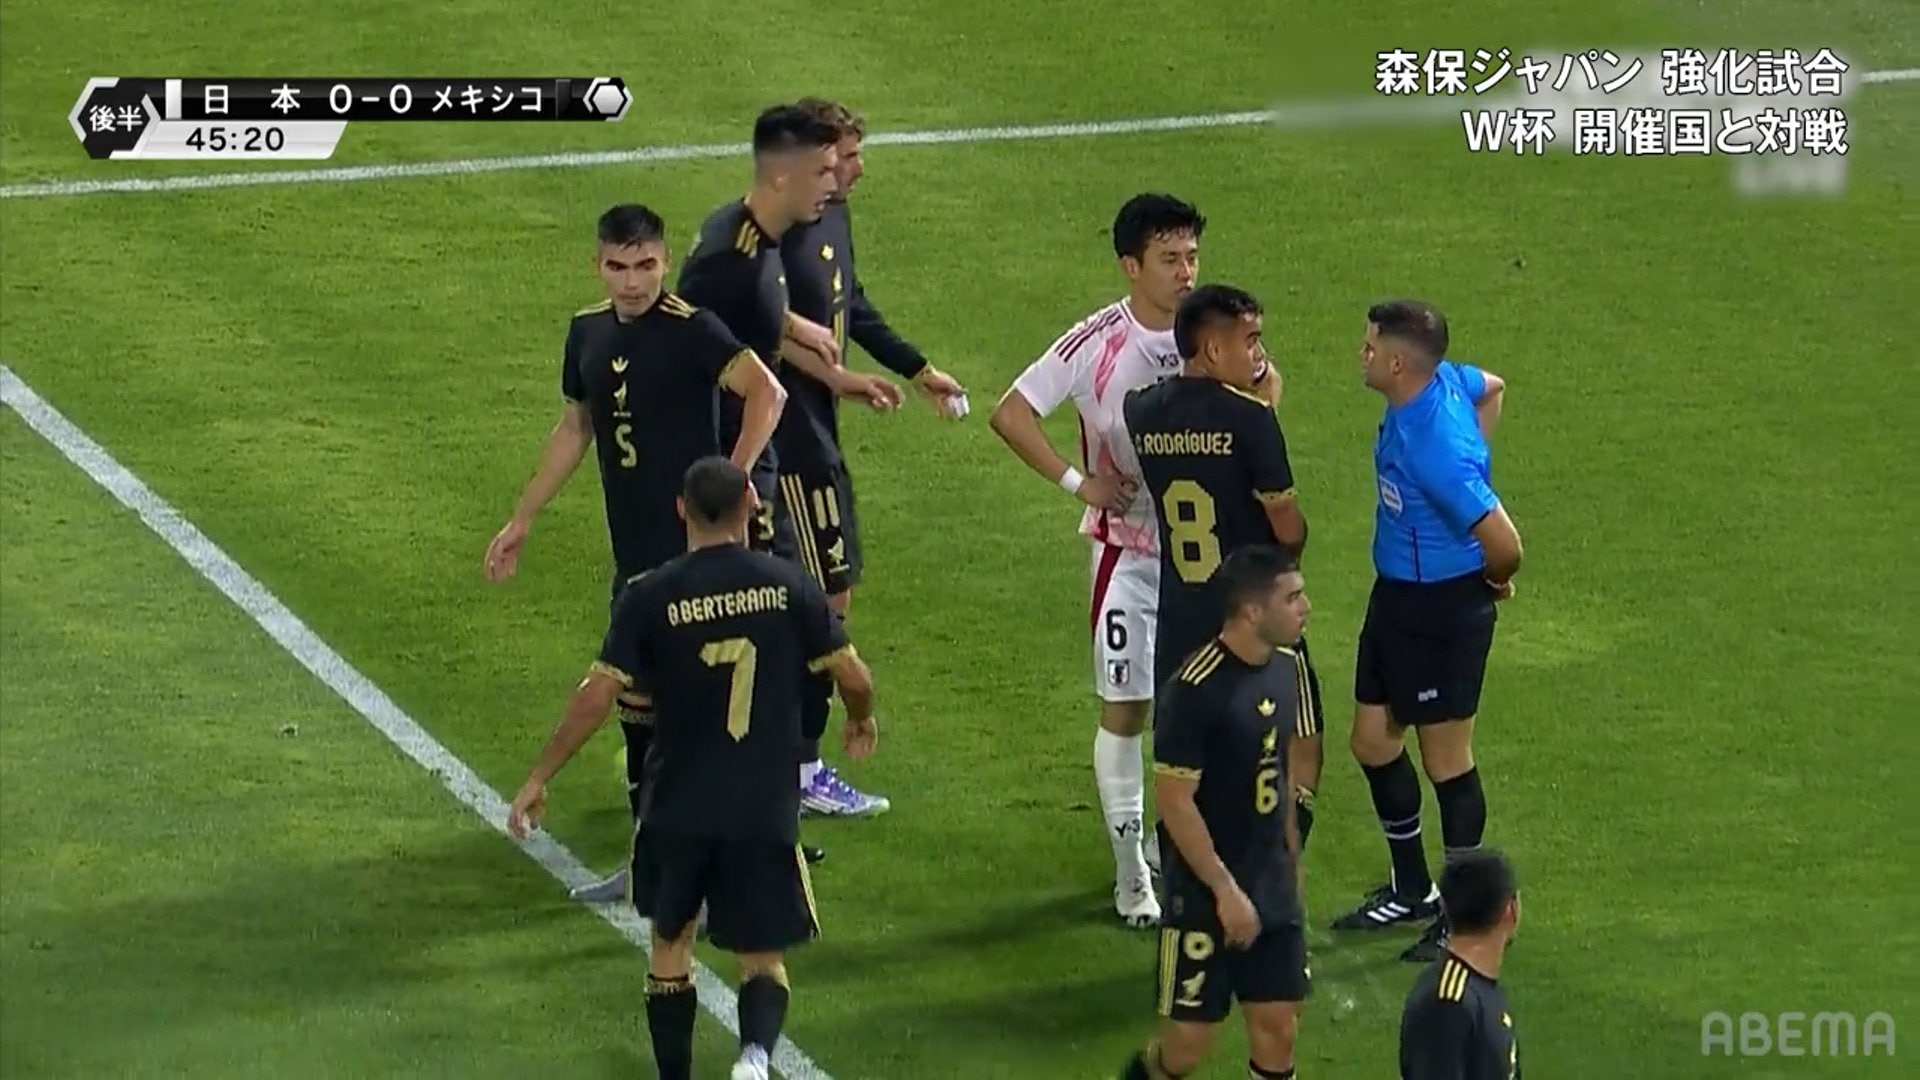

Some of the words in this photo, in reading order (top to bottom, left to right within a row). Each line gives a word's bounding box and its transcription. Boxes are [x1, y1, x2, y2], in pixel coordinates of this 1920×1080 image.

[615, 423, 638, 468] 5
[813, 486, 840, 530] 11
[1162, 479, 1223, 584] 8
[1105, 608, 1127, 651] 6
[699, 637, 757, 743] 7
[1255, 768, 1280, 816] 6
